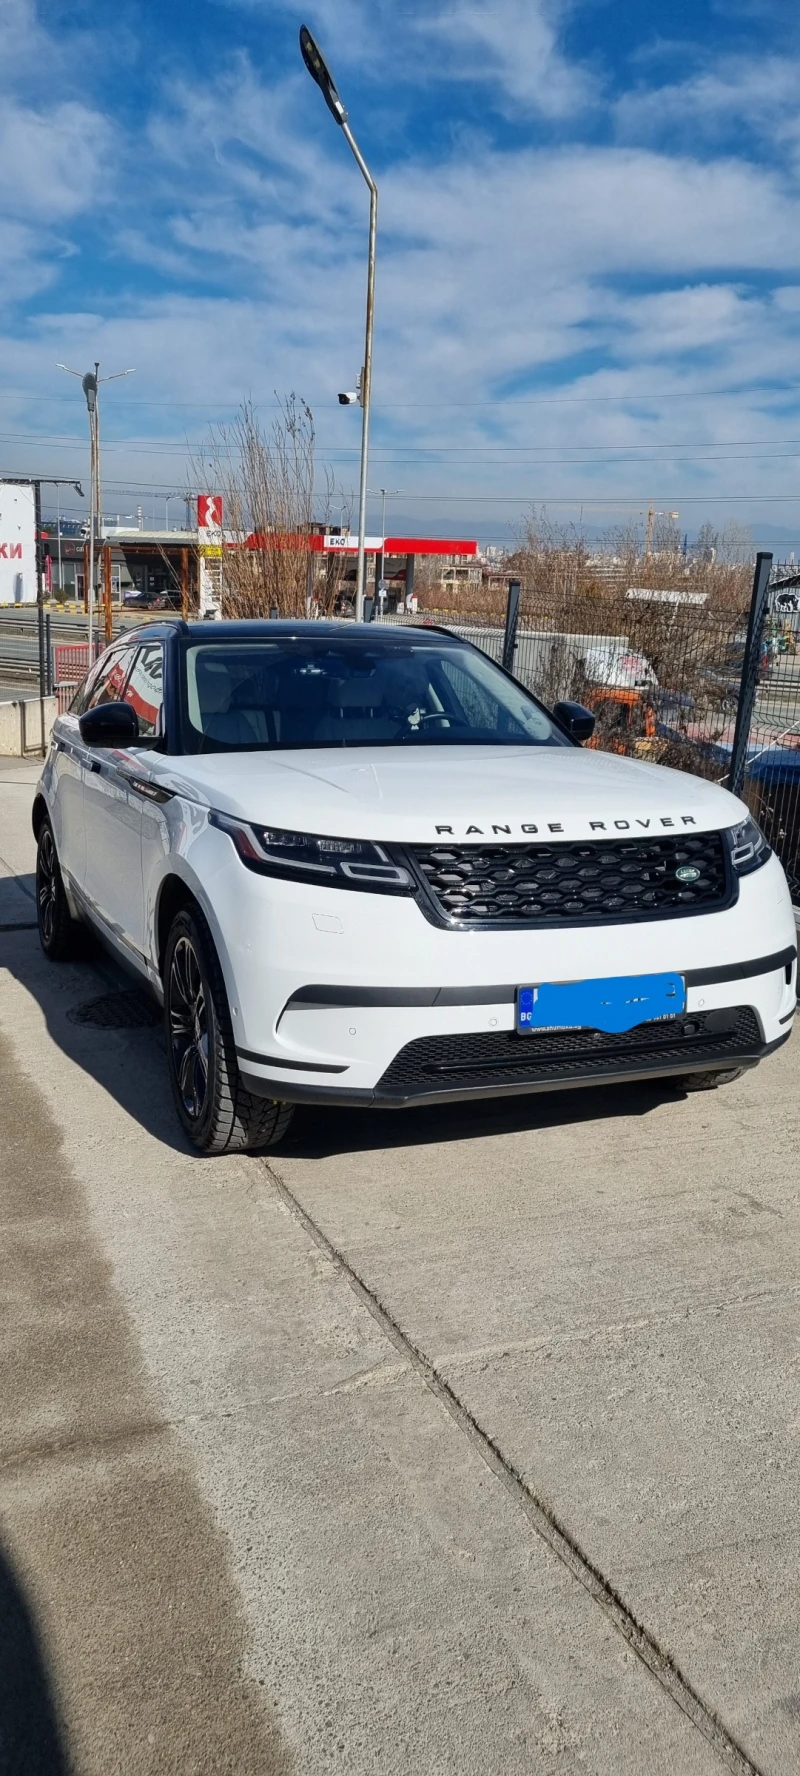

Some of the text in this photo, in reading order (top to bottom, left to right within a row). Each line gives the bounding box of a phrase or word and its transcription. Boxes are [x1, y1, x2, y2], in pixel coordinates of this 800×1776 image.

[330, 538, 346, 546] EKO
[435, 816, 697, 835] RANGE ROVER
[520, 1012, 532, 1022] BG
